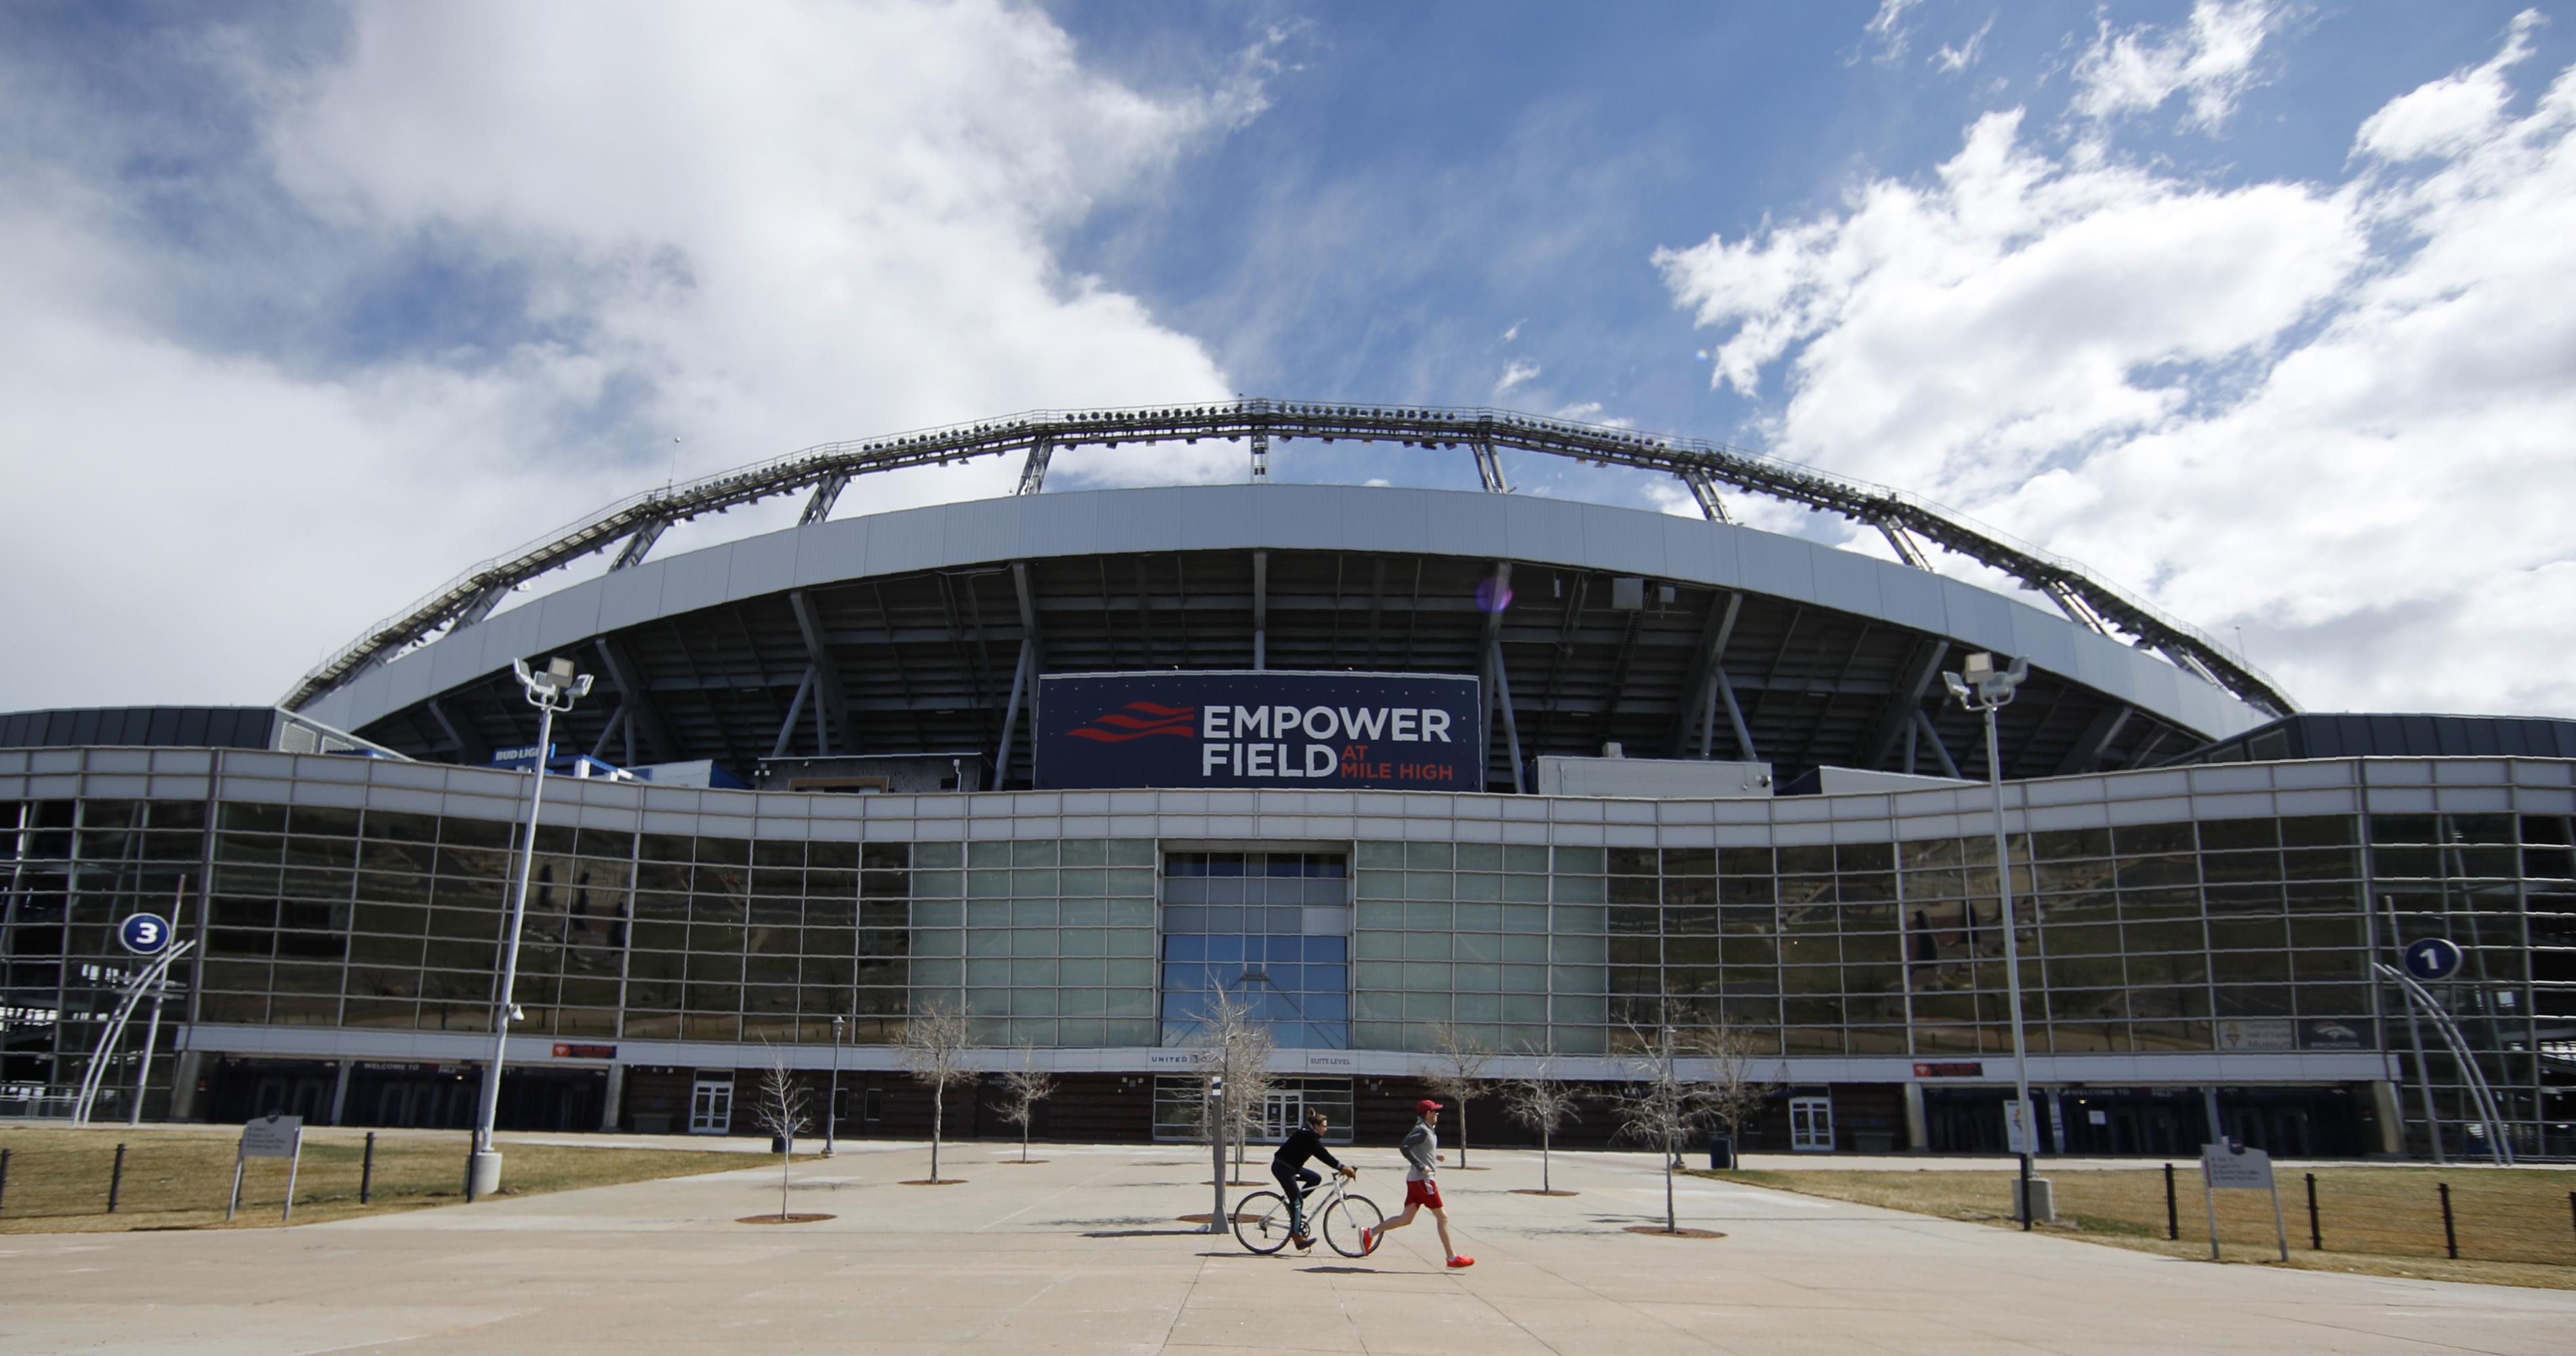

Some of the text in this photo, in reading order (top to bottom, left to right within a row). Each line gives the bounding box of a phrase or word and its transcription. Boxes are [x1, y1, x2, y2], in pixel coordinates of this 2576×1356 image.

[1203, 705, 1451, 742] EMPOWER
[496, 750, 518, 761] BUD
[1203, 743, 1338, 777] FIELD
[1341, 745, 1368, 761] AT
[1341, 763, 1453, 780] MILE HIGH
[136, 922, 159, 944] 3
[2419, 948, 2438, 970] 1
